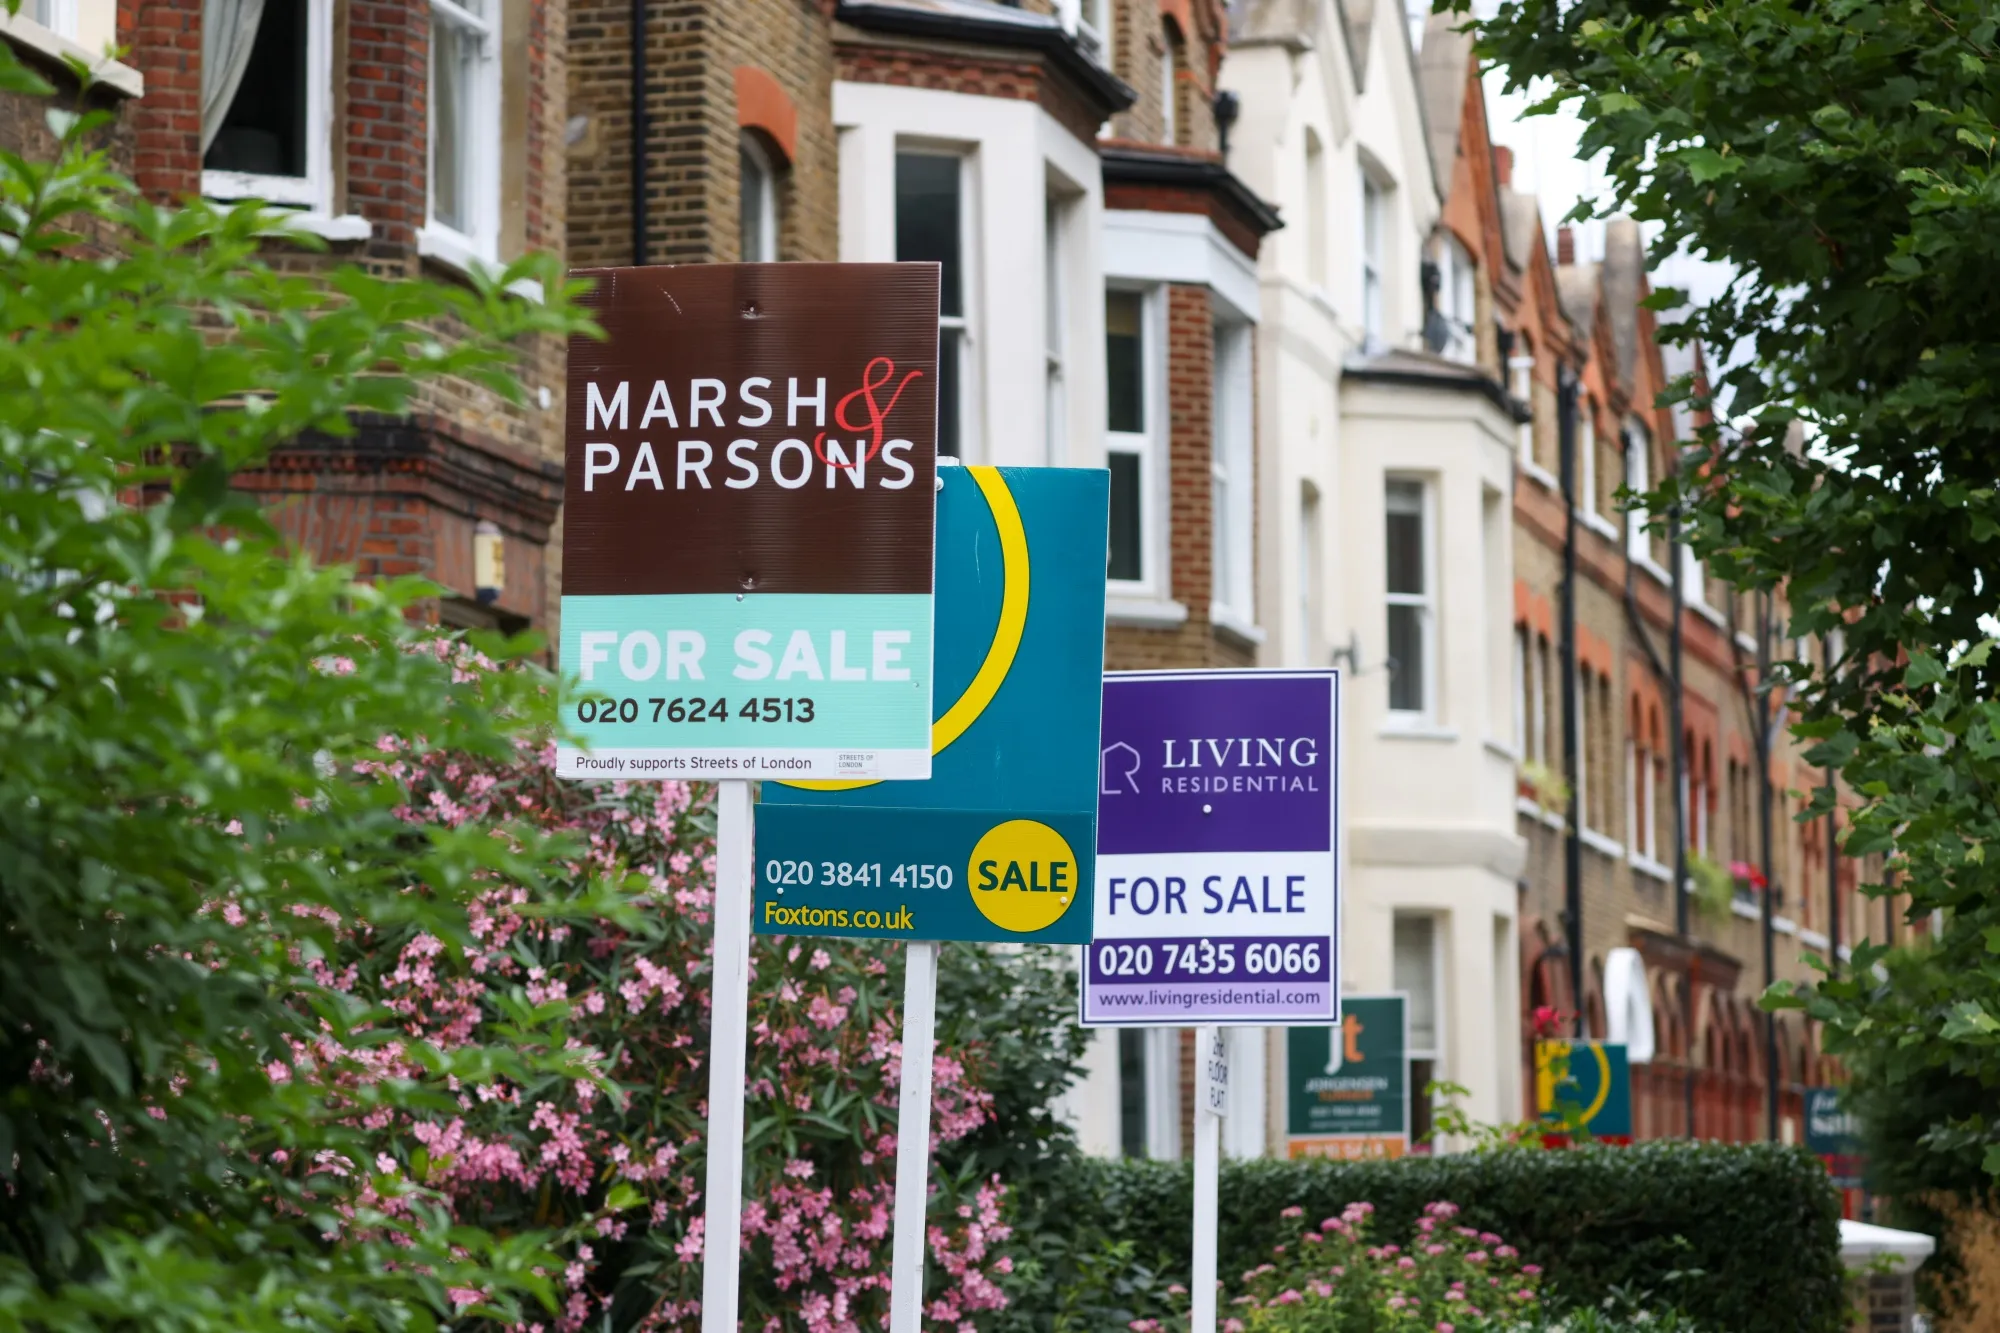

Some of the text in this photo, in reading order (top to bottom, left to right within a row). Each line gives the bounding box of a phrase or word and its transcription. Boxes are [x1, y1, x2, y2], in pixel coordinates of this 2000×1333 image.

[585, 356, 924, 469] MARSH &
[584, 438, 914, 492] PARSONS
[580, 629, 911, 682] FOR SALE
[577, 697, 815, 723] 020 7624 4513
[576, 755, 812, 772] Proudly supports Streets of London
[1162, 737, 1319, 768] LIVING
[1162, 775, 1319, 793] RESIDENTIAL
[766, 859, 953, 889] 020 3841 4150
[977, 860, 1069, 892] SALE
[1109, 875, 1306, 915] FOR SALE
[765, 901, 914, 930] Foxtons.co.uk
[1099, 943, 1321, 976] 020 7435 6066
[1099, 988, 1321, 1008] www.livingresidential.com
[1208, 1060, 1229, 1085] FLOOR
[1210, 1086, 1225, 1110] FLAT
